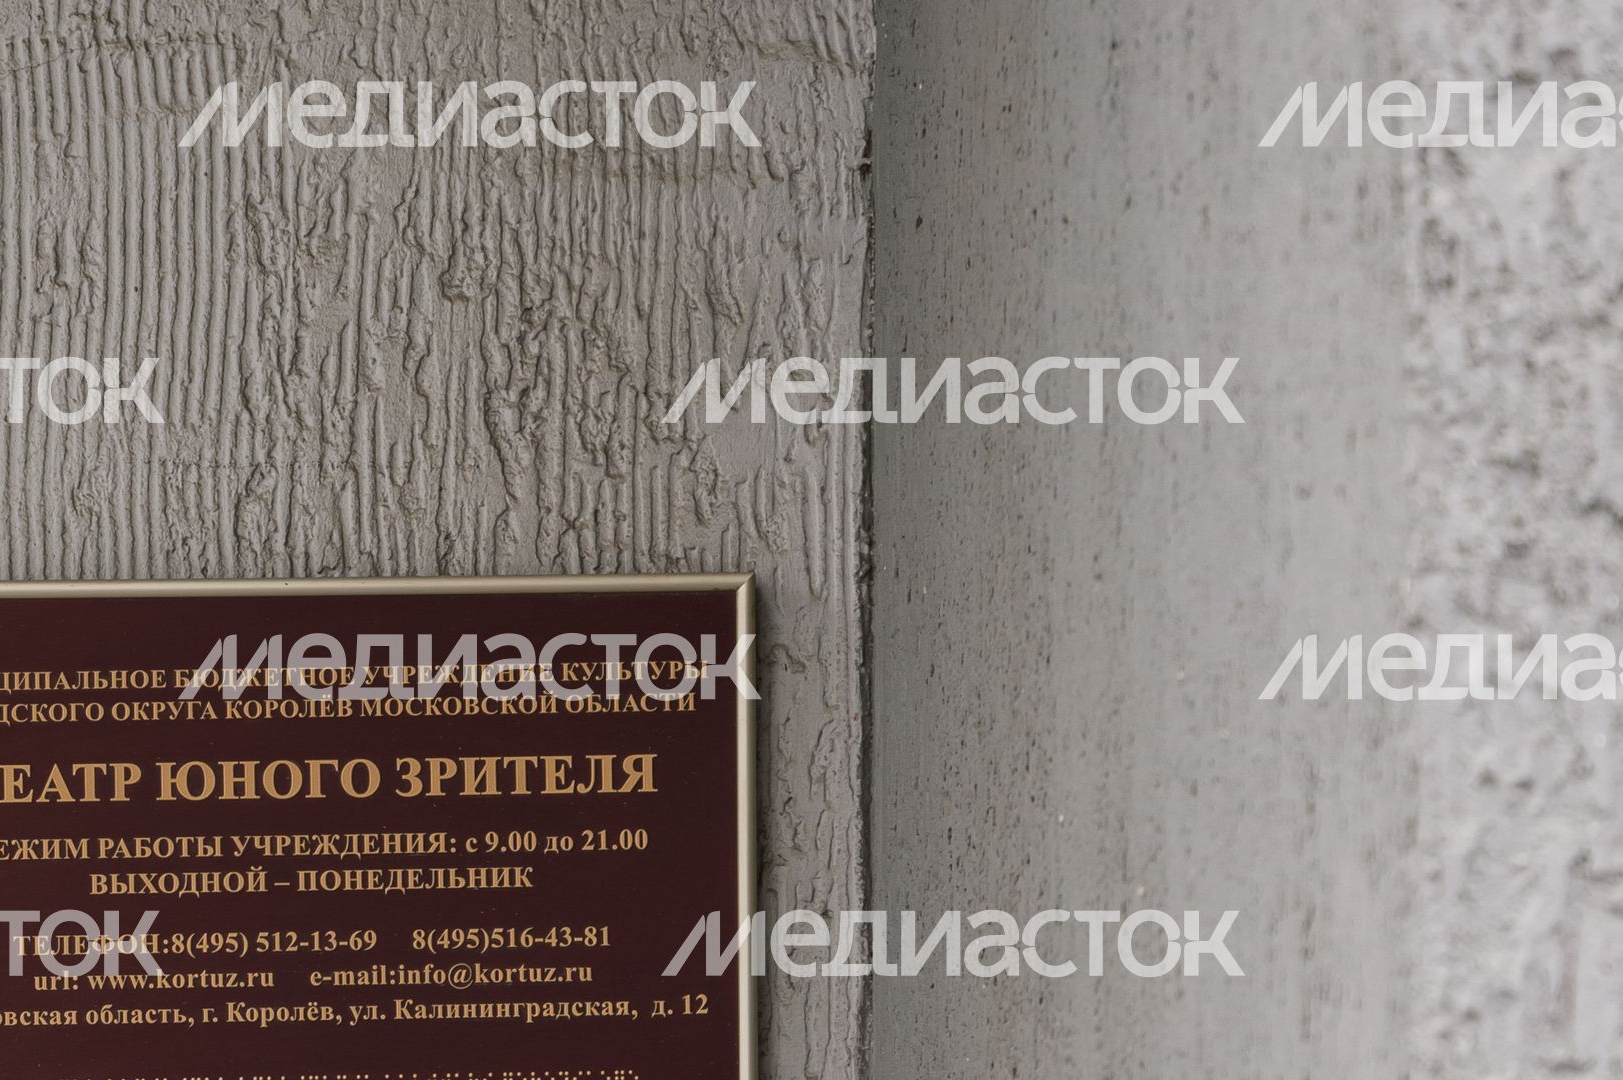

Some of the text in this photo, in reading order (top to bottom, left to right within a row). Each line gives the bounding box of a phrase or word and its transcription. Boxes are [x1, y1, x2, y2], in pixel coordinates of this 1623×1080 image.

[173, 666, 355, 692] БЮДЖЕТНОЕ
[363, 662, 554, 688] УЧРЕЖДЕНИЕ
[561, 660, 709, 682] КУЛЬТУРЫ
[111, 700, 218, 721] ОКРУГА
[225, 695, 353, 720] КОРОЛЁВ
[361, 691, 559, 719] МОСКОВСКОЙ
[565, 692, 697, 714] ОБЛАСТИ
[156, 759, 381, 801] ЮНОГО
[395, 754, 658, 798] ЗРИТЕЛЯ
[97, 836, 224, 859] РАБОТЫ
[231, 832, 457, 860] УЧРЕЖДЕНИЯ:
[485, 831, 538, 853] 9.00
[544, 835, 575, 855] до
[581, 829, 649, 851] 21.00
[89, 866, 269, 898] ВЫХОДНОЙ
[297, 866, 534, 895] ПОНЕДЕЛЬНИК
[256, 930, 377, 953] 512-13-69
[412, 925, 612, 954] 8(495)516-43-81
[33, 962, 594, 991] url: www.kortuz.ru e-mail:info@kortuz.ru
[85, 1003, 195, 1028] область,
[202, 1008, 218, 1025] г.
[226, 1001, 344, 1028] Королёв,
[349, 1004, 386, 1026] ул.
[394, 997, 639, 1024] Калининградская,
[652, 1000, 673, 1018] д.
[682, 994, 709, 1016] 12
